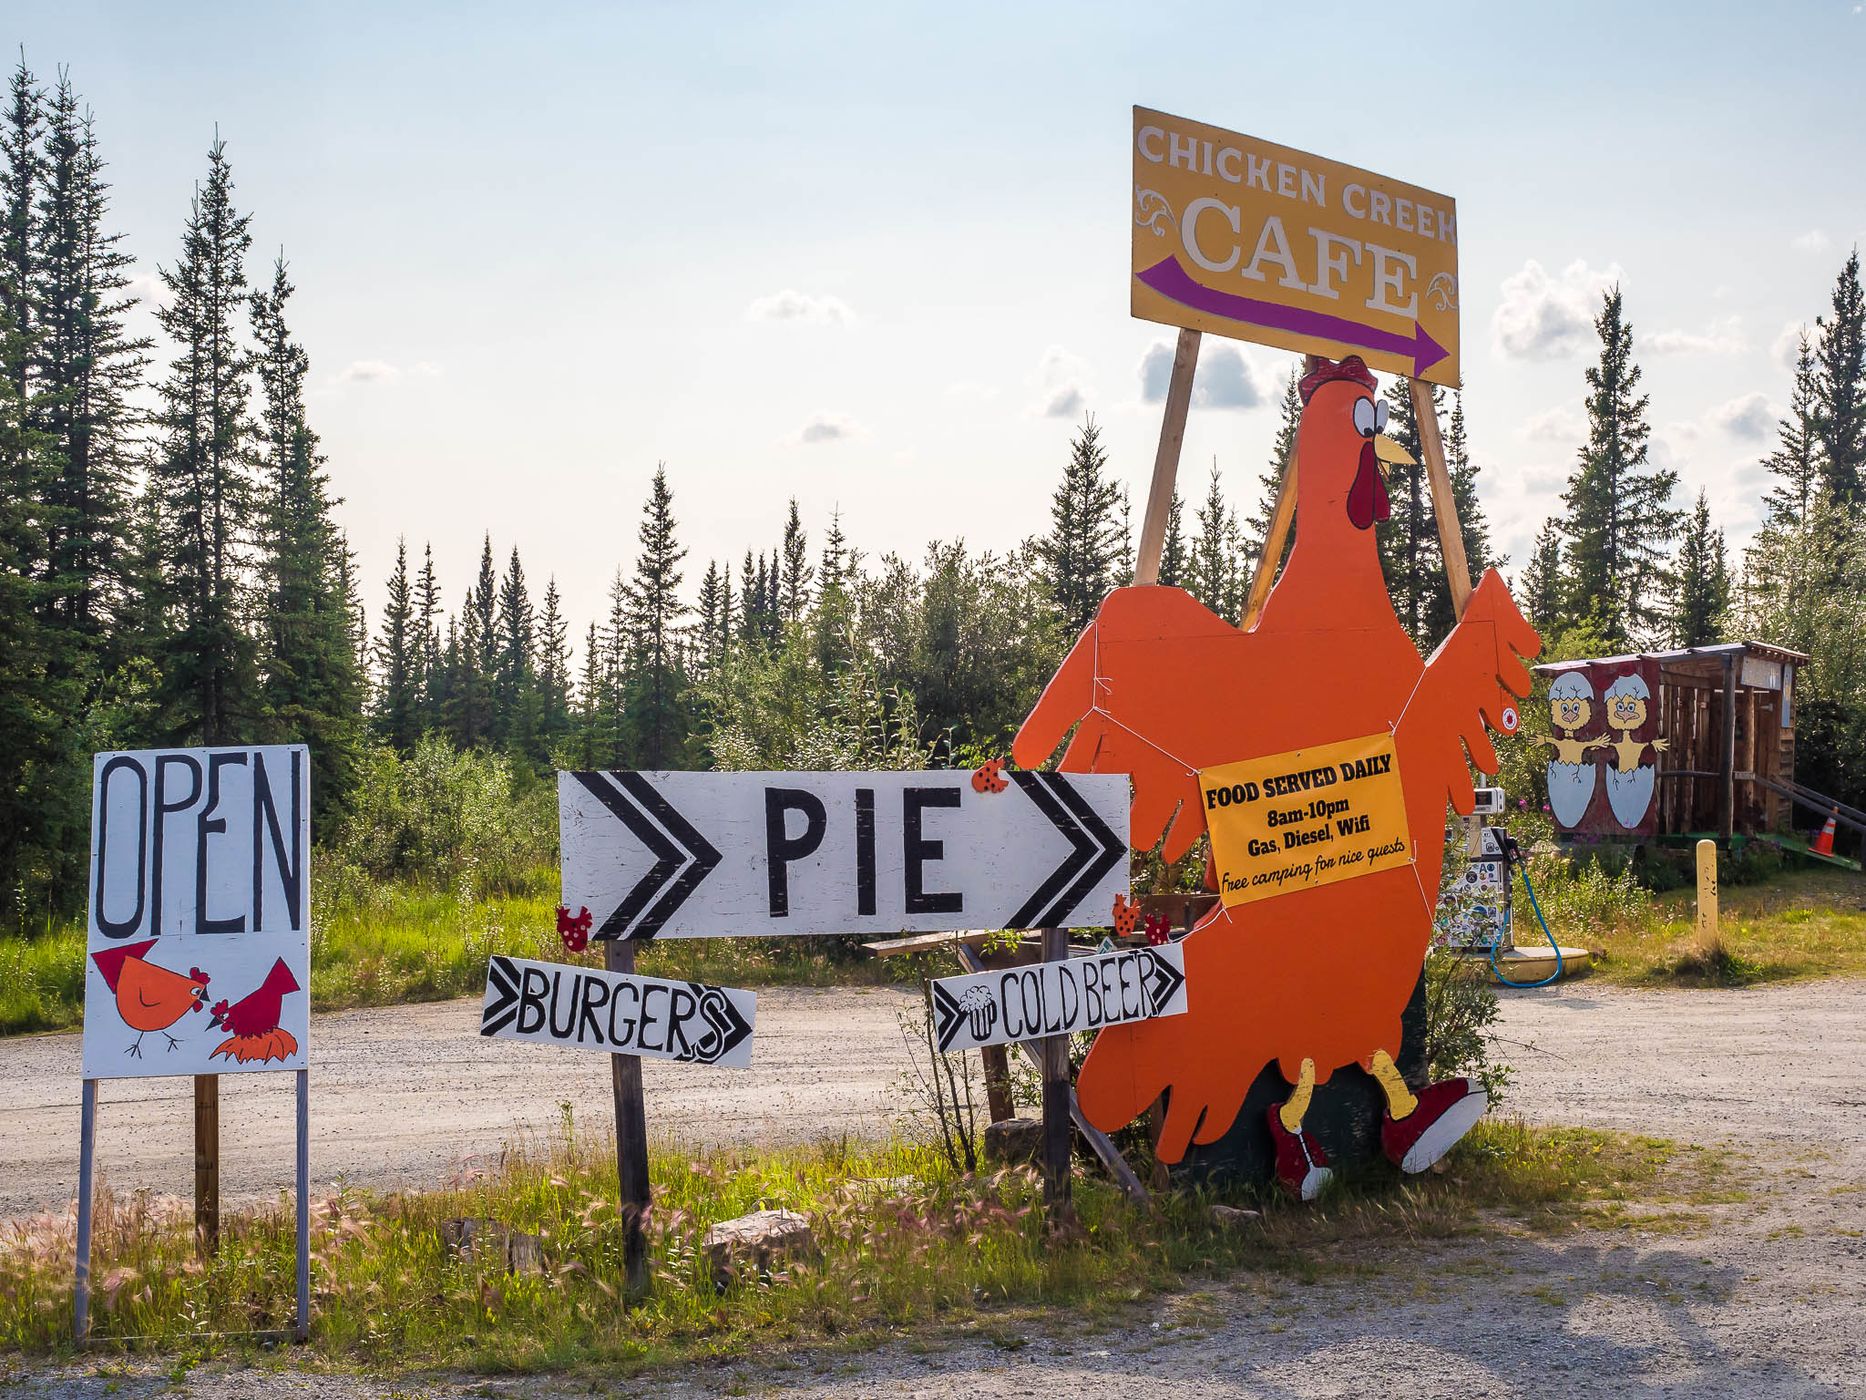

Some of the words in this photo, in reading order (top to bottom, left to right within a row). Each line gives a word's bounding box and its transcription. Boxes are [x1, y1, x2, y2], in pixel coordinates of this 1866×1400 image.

[1137, 125, 1327, 207] CHICKEN
[1342, 183, 1456, 246] CREEK
[1180, 197, 1418, 320] CAFE
[1206, 782, 1259, 809] FOOD
[1263, 766, 1337, 797] SERVED
[1342, 754, 1391, 781] DAILY
[1267, 799, 1350, 828] 8am-10pm
[95, 750, 301, 939] OPEN
[764, 787, 962, 917] PIE
[1247, 838, 1281, 857] Gas,
[1283, 825, 1334, 850] Diesel,
[1336, 814, 1371, 837] Wifi
[1252, 863, 1313, 886] camping
[1314, 854, 1335, 874] for
[1338, 850, 1364, 867] nice
[1367, 836, 1406, 866] guests
[516, 967, 727, 1059] BURGERS
[1001, 968, 1078, 1039] COLD
[1083, 950, 1159, 1027] BEER
